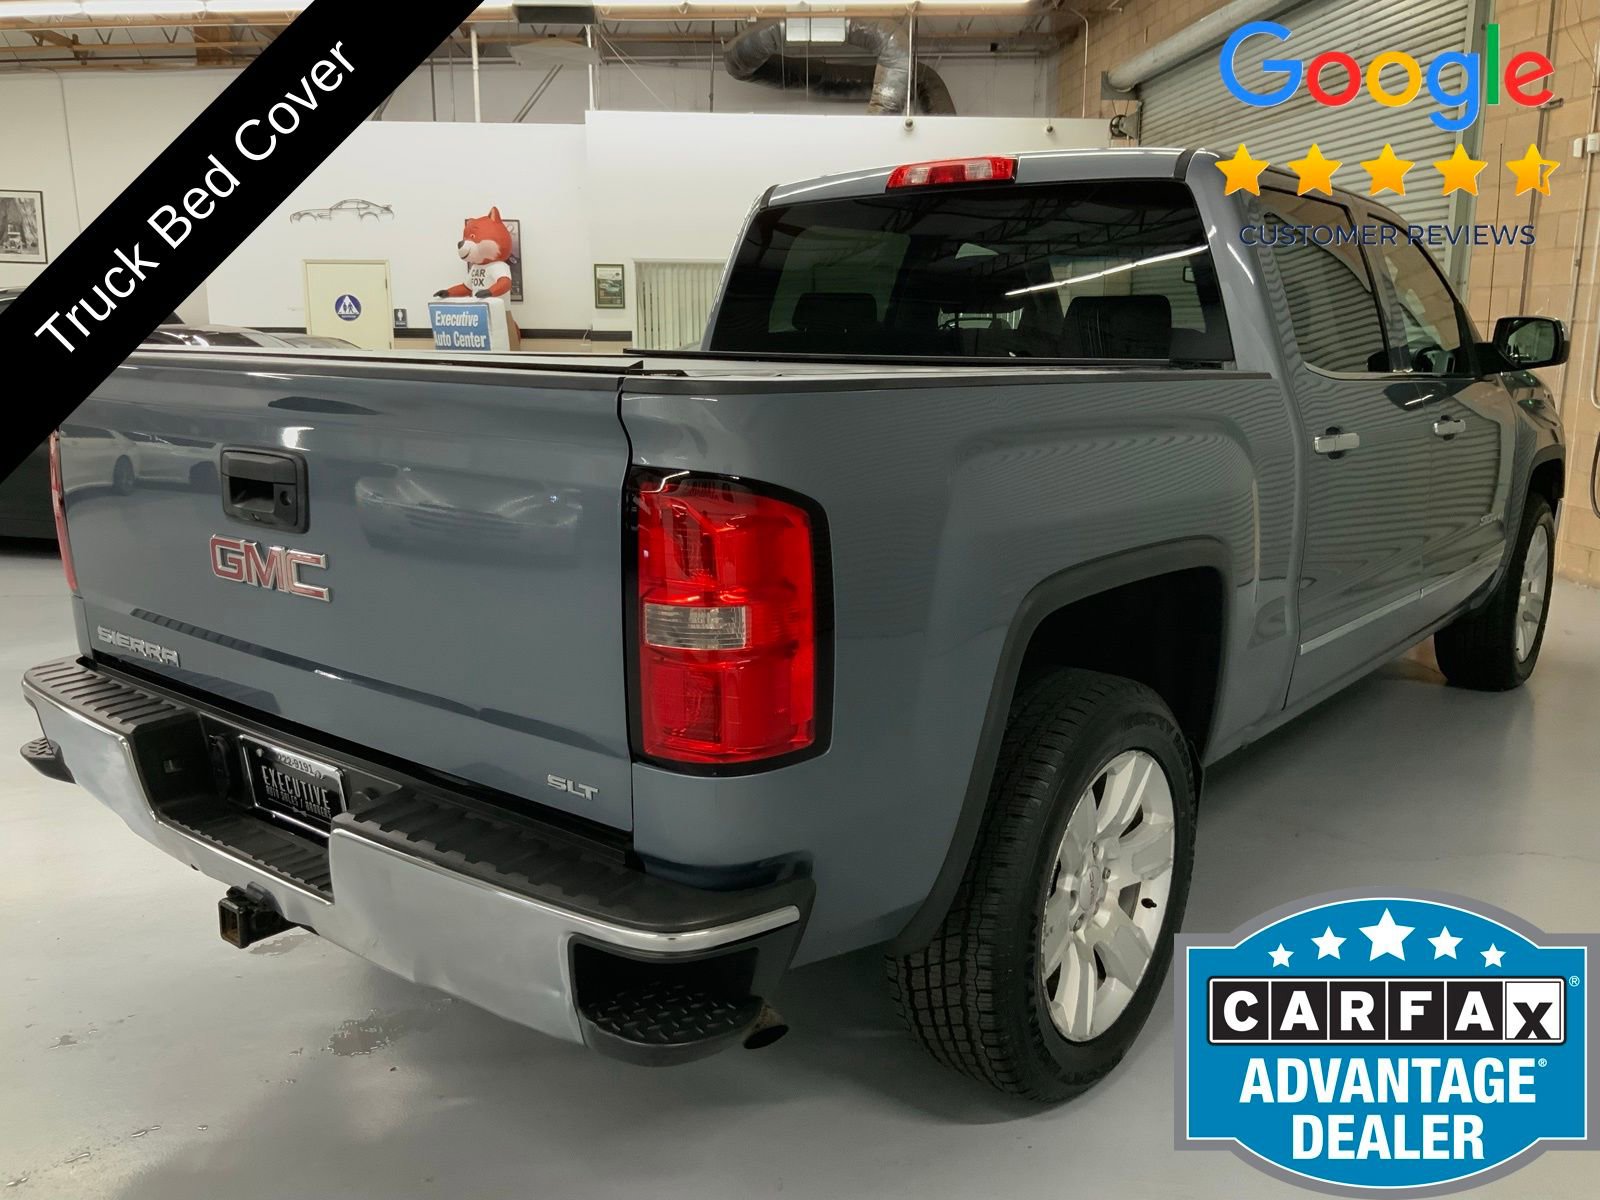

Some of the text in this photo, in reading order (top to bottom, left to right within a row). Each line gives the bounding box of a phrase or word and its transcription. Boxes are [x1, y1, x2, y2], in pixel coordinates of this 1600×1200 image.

[471, 268, 486, 278] CAR
[435, 310, 479, 327] Executive
[453, 331, 487, 348] Center
[209, 534, 331, 602] GMC
[97, 625, 181, 667] SIERRA
[262, 765, 330, 810] EXECUTIVE
[547, 774, 600, 801] SLT
